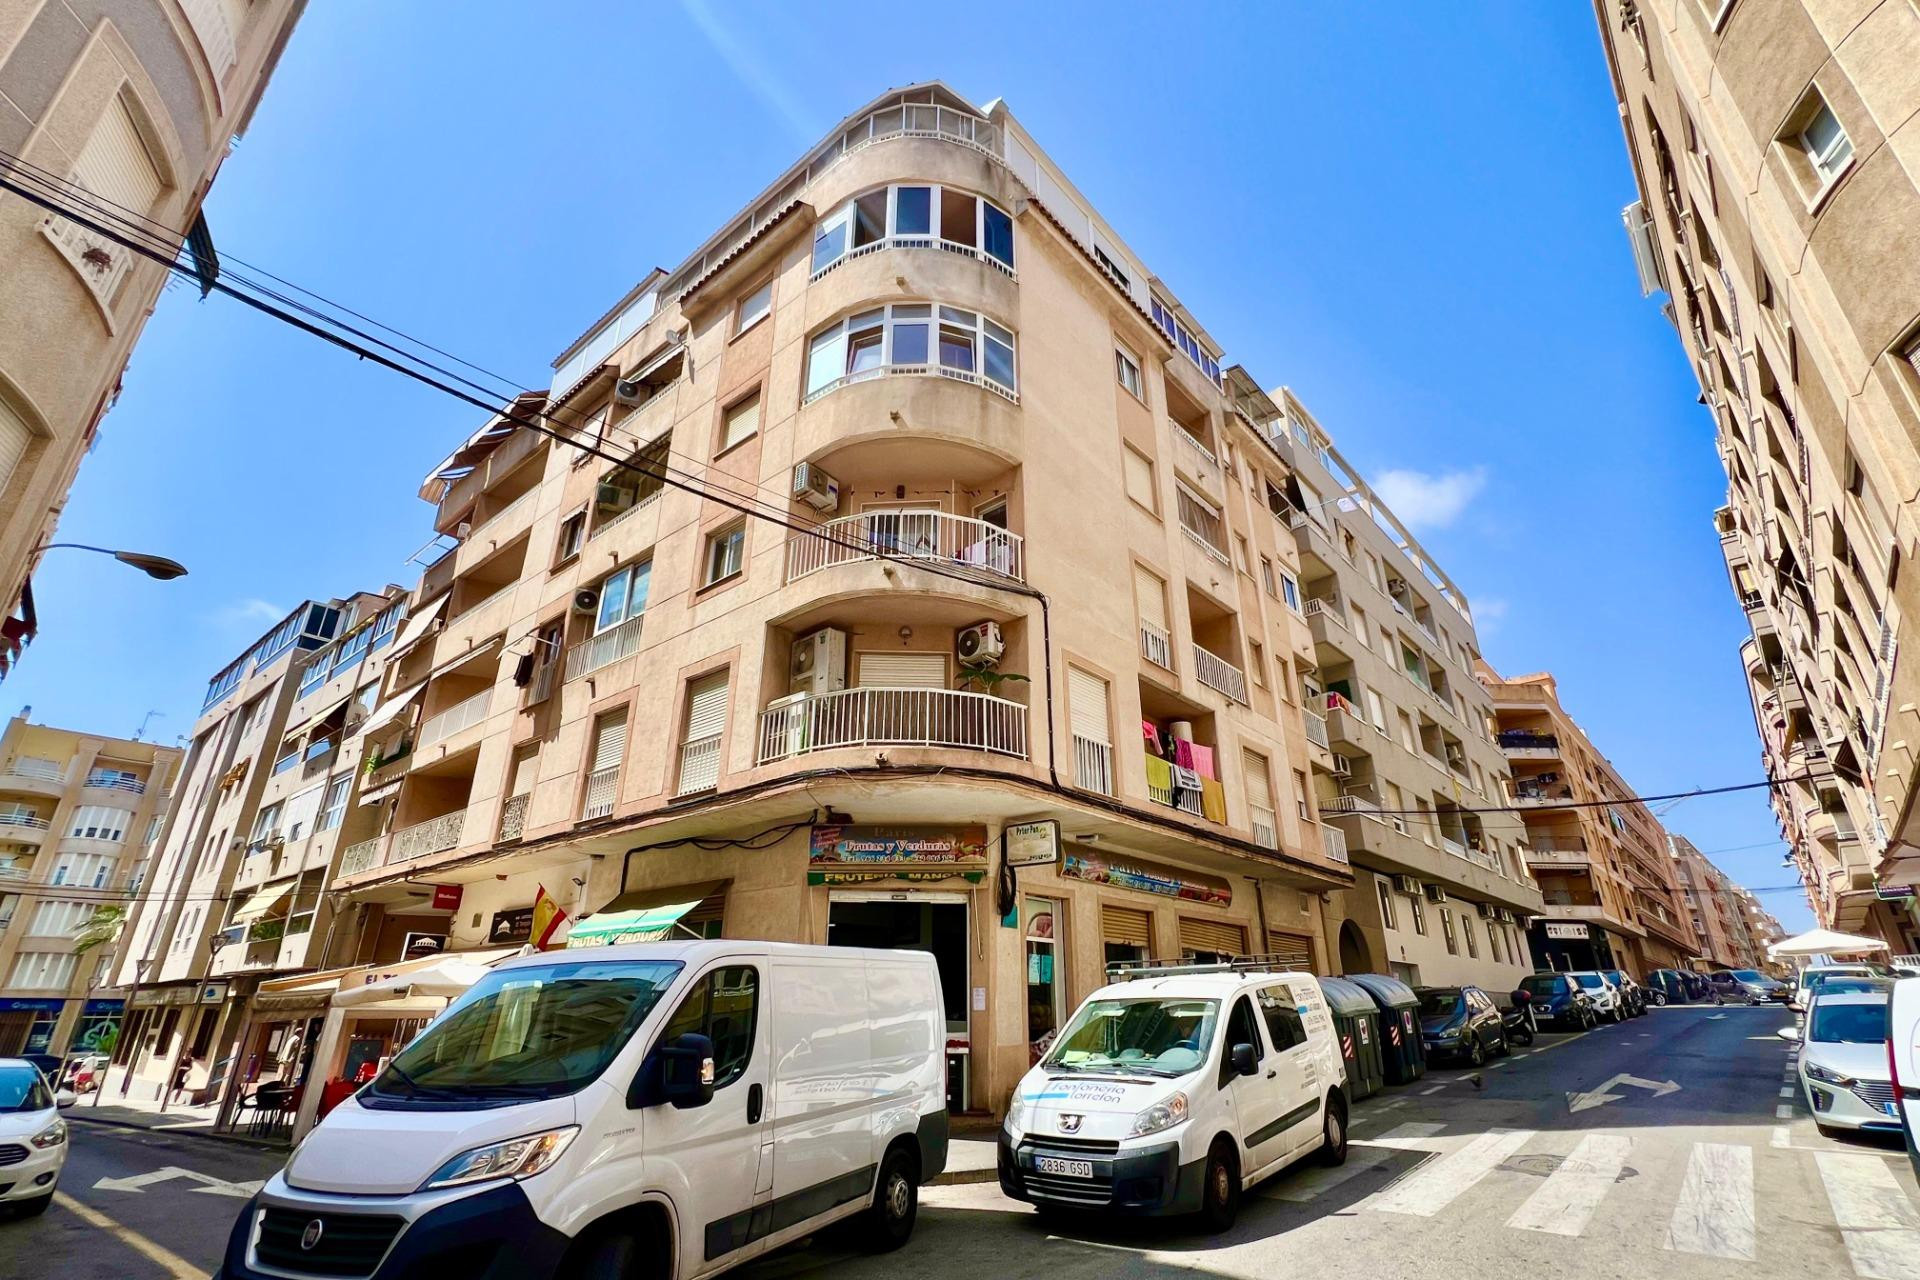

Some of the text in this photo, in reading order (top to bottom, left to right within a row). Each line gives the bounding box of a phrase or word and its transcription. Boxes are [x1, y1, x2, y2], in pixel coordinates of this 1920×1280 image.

[844, 839, 951, 853] Frutas y Verduras
[567, 935, 601, 949] FRUTAS
[611, 929, 669, 945] VERDUR
[1041, 1158, 1090, 1176] 2836 GSD
